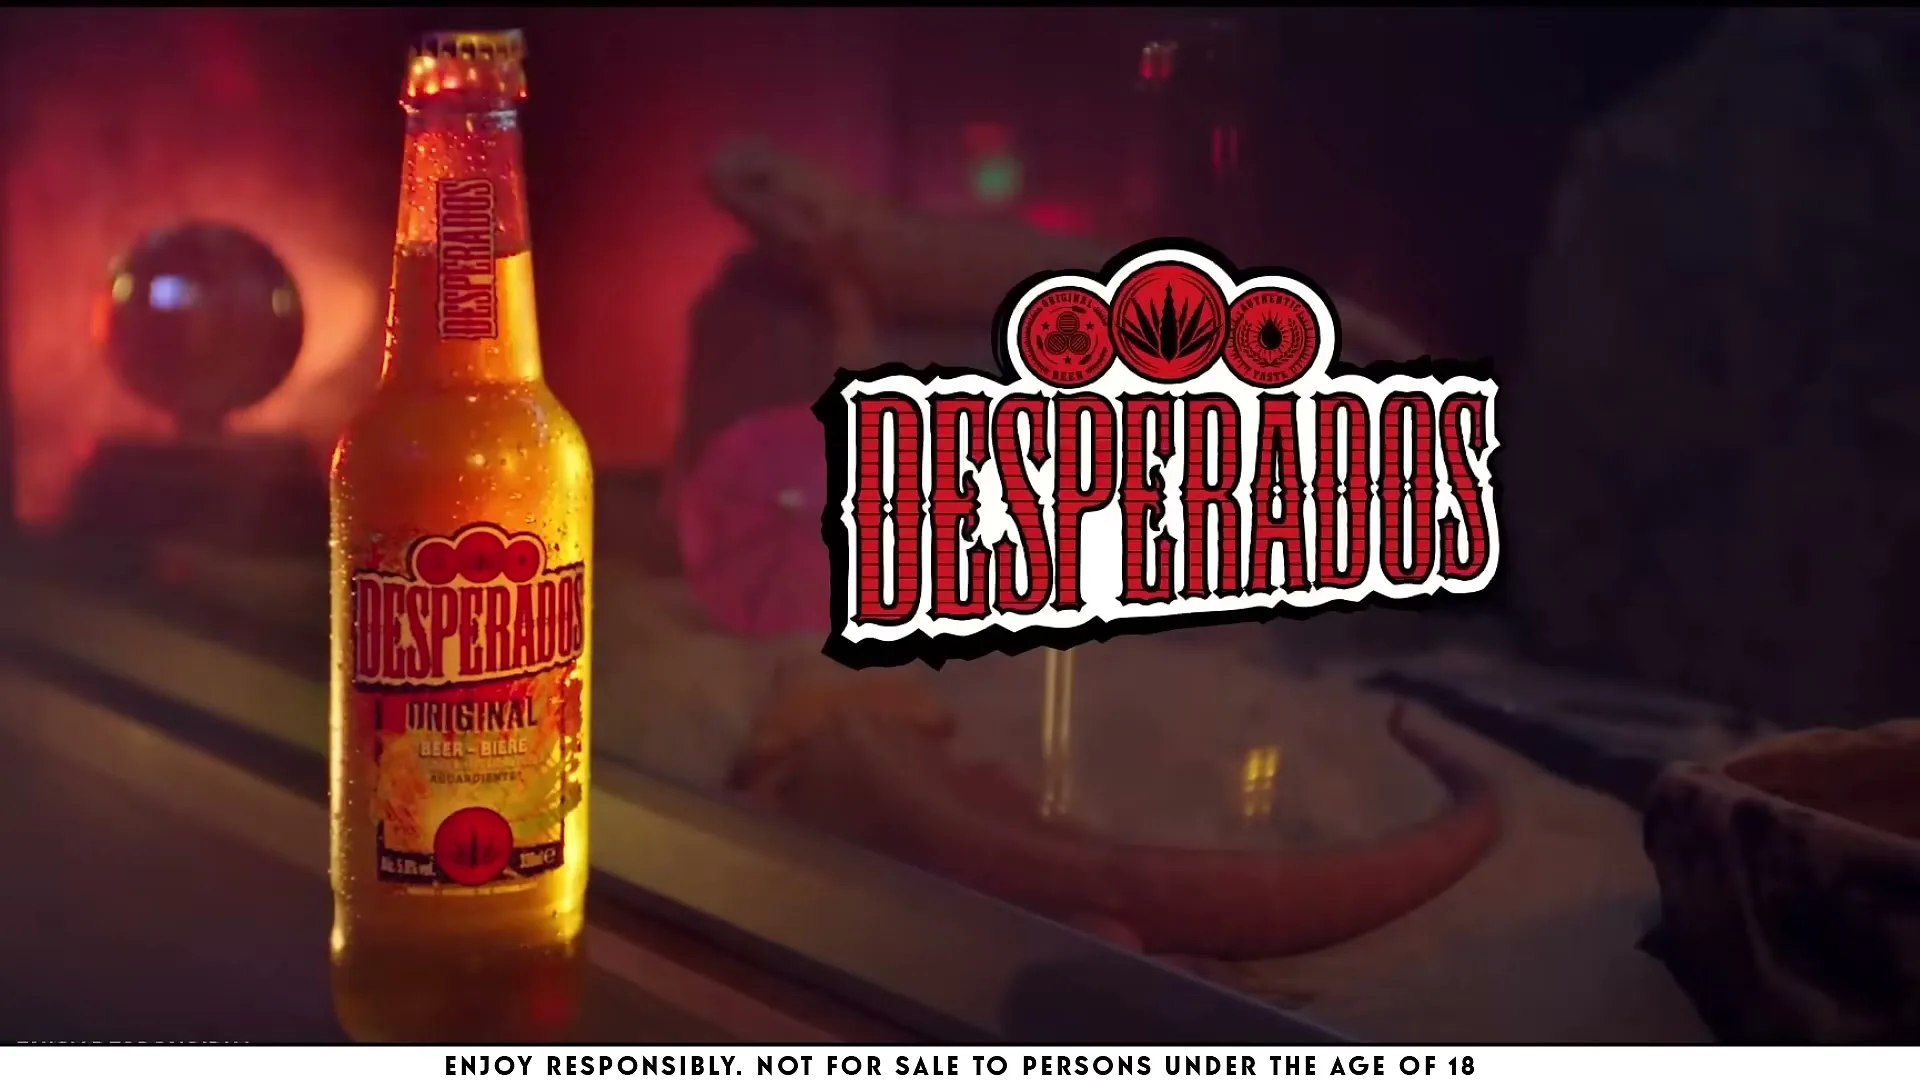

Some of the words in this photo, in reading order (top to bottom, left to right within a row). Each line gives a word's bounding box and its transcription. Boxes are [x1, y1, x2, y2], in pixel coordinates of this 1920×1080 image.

[442, 180, 493, 335] DESPERADOS
[357, 573, 582, 679] DESPERADOS
[405, 696, 538, 734] ORIGINAL
[419, 741, 464, 758] BEER
